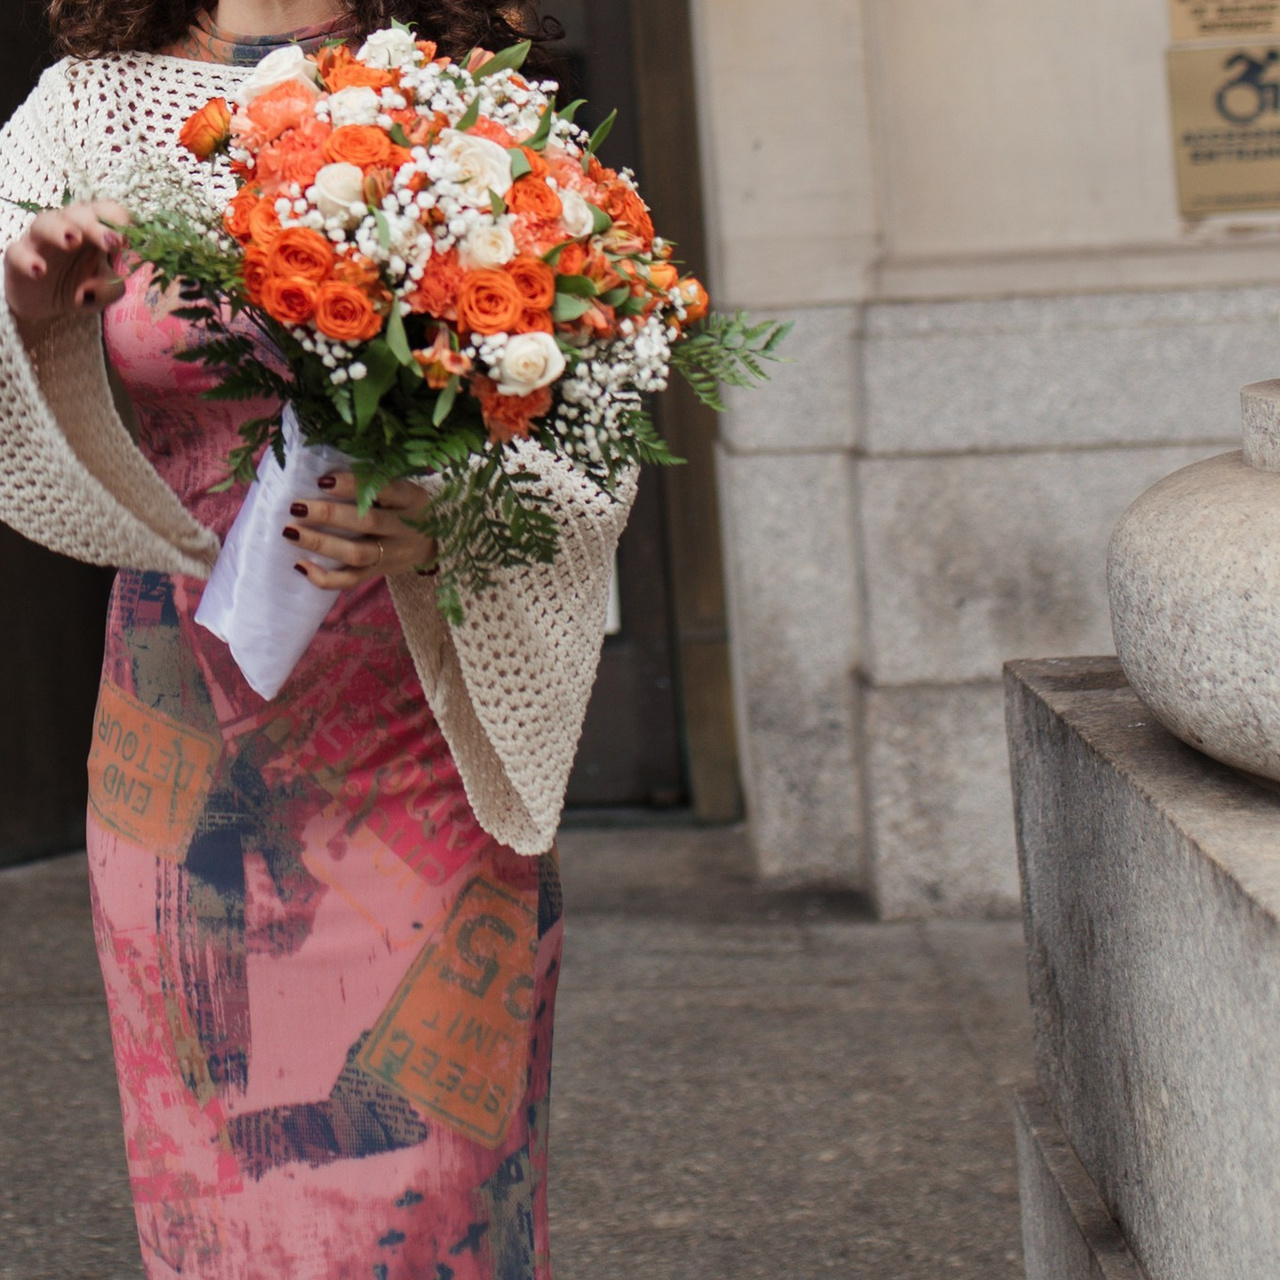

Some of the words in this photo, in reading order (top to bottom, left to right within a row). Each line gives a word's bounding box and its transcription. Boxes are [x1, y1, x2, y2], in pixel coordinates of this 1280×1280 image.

[98, 708, 196, 791] DETOUR
[103, 763, 152, 816] END
[422, 1011, 517, 1059] LIMIT
